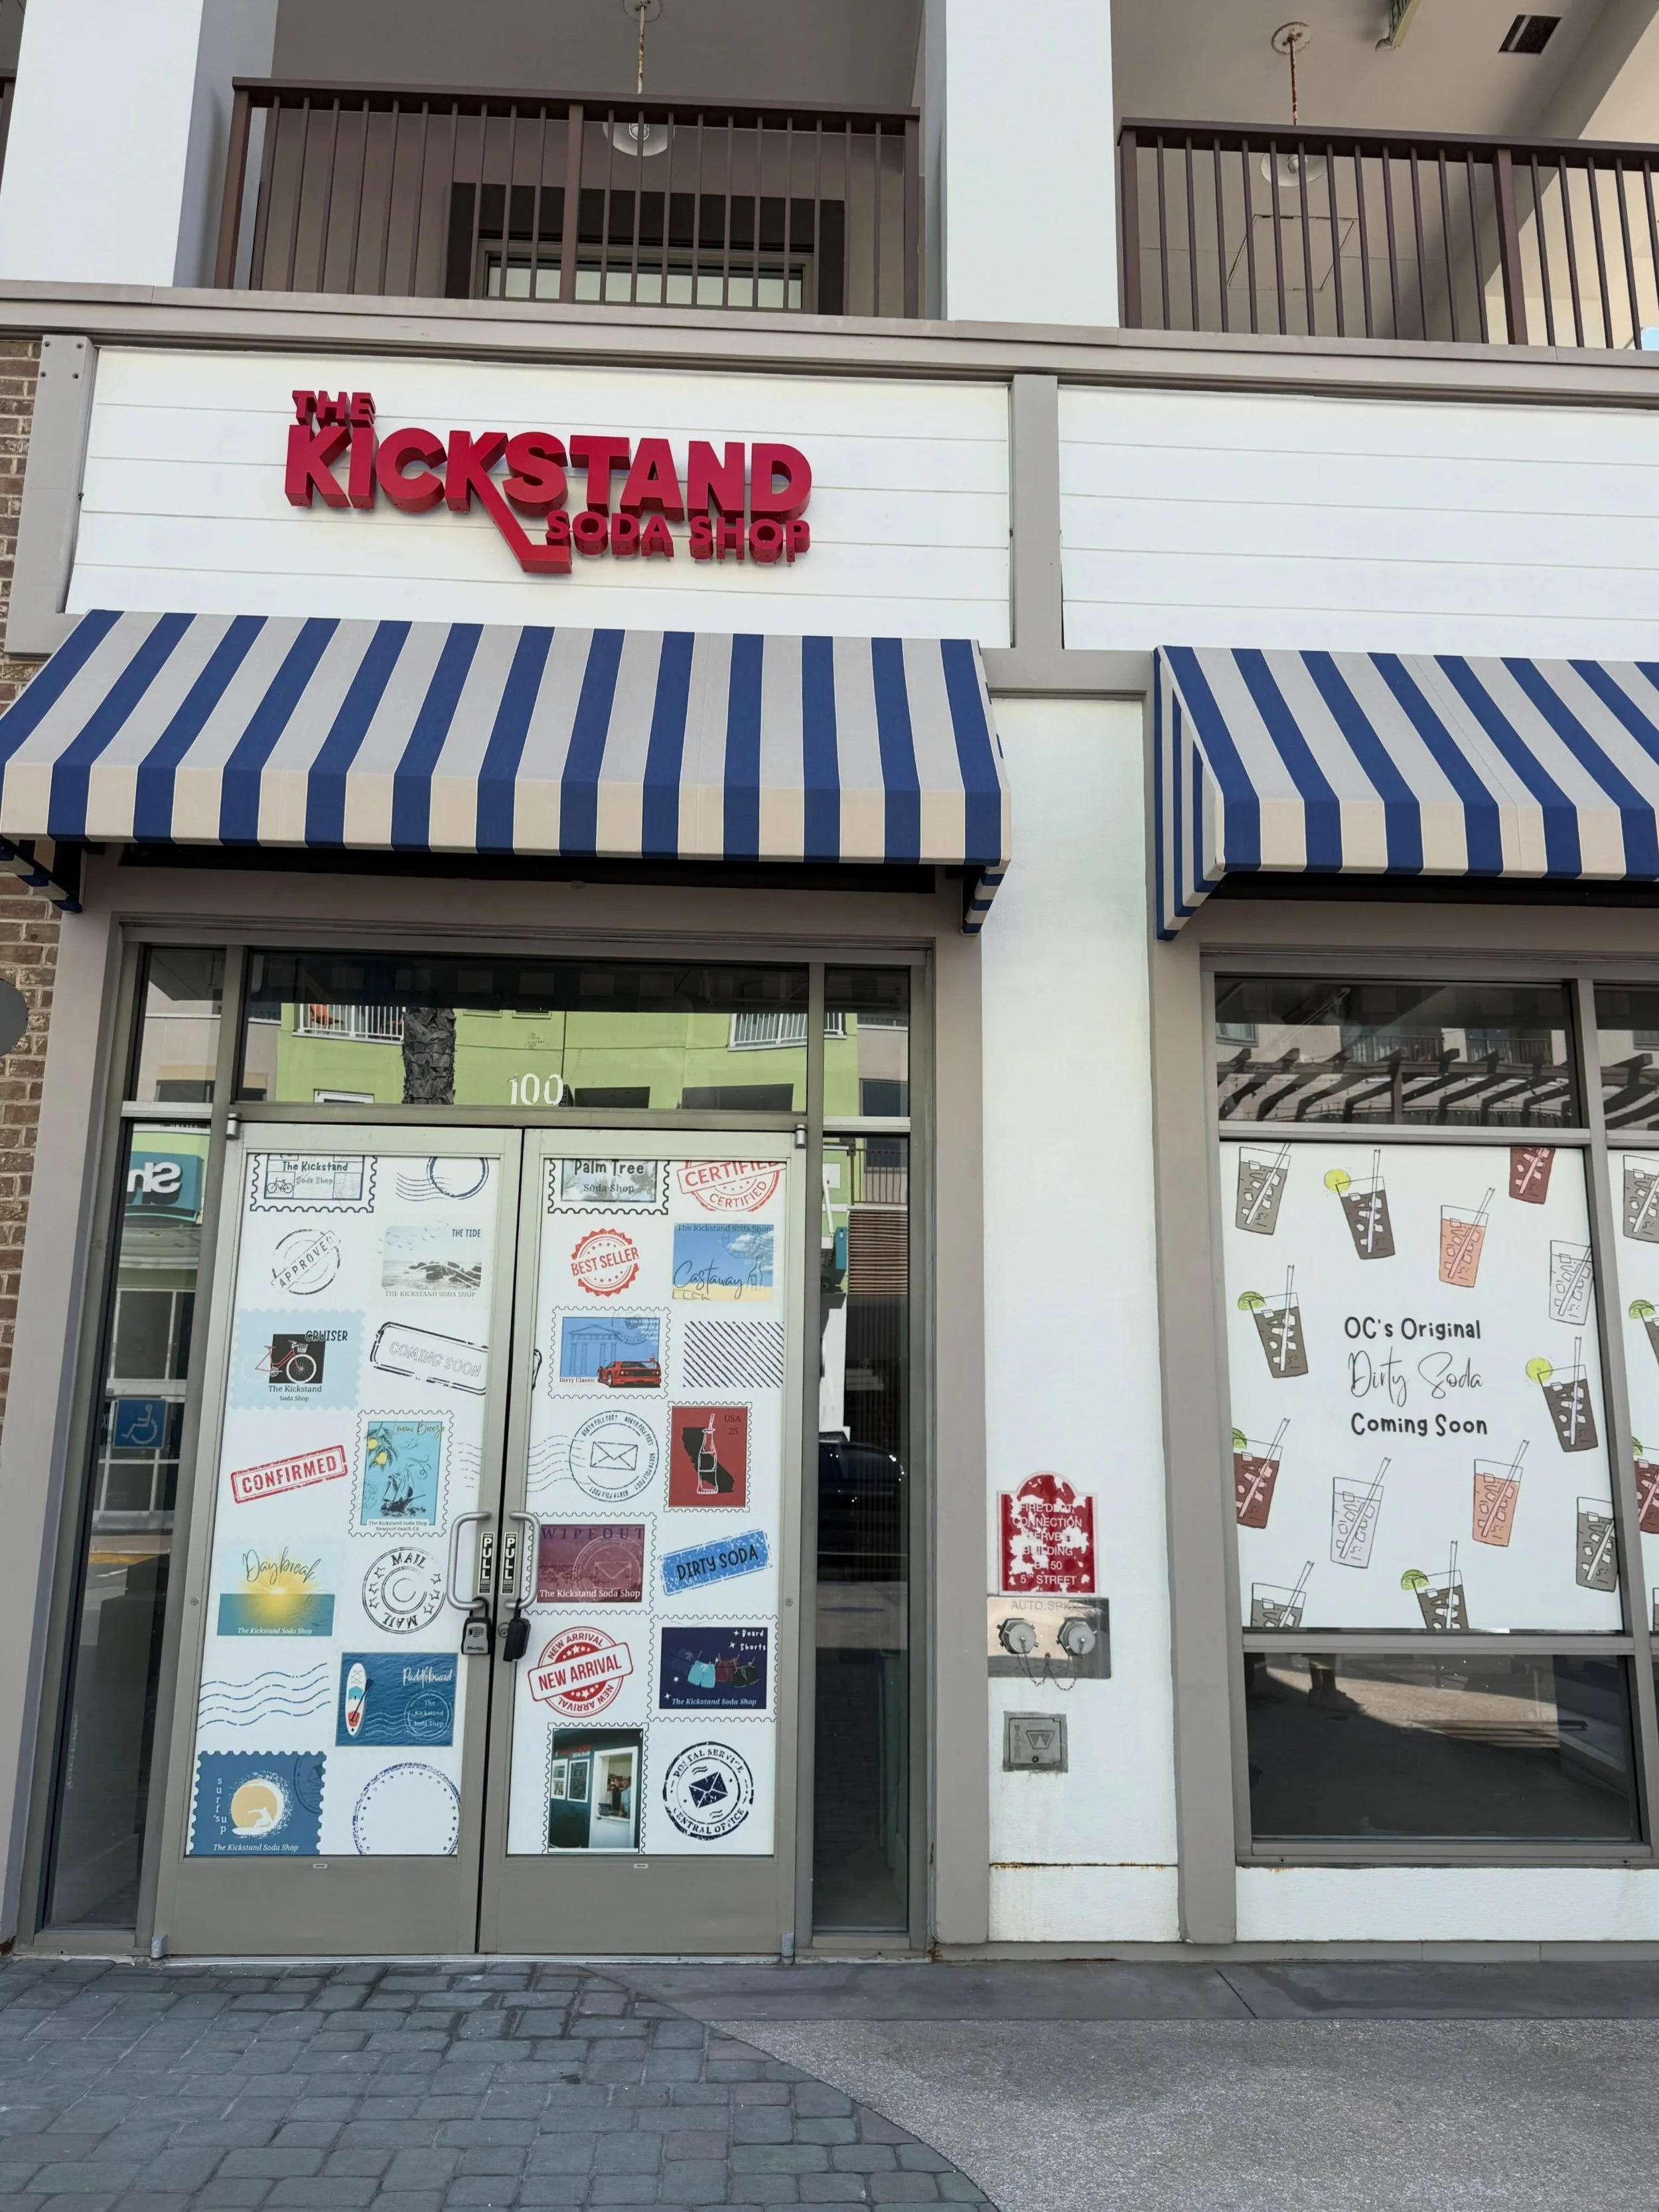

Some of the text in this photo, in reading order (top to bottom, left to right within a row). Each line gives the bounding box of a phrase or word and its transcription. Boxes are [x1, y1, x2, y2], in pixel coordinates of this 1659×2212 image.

[292, 390, 376, 428] THE
[285, 424, 812, 574] KICKSTAND
[545, 510, 810, 563] SODA SHOP
[507, 1073, 563, 1106] 100
[283, 1161, 348, 1171] The Kickstand
[575, 1159, 644, 1175] Palm Tree
[685, 1161, 781, 1187] CERTIFIE
[315, 1177, 332, 1185] Shop
[611, 1184, 634, 1194] Shop
[709, 1181, 766, 1208] CERTIFIED
[452, 1228, 480, 1237] THE TIDE
[752, 1225, 771, 1234] Shop
[571, 1247, 639, 1276] BEST SELLER
[674, 1258, 743, 1299] Castaway
[1344, 1316, 1481, 1341] OC's Original
[390, 1341, 482, 1377] COMING SOON
[1348, 1346, 1483, 1407] Dirty Soda
[1351, 1412, 1488, 1437] Coming Soon
[242, 1455, 336, 1493] CONFIRMED
[1021, 1503, 1043, 1512] FIRE
[541, 1528, 644, 1540] WIPEOUT
[1012, 1517, 1082, 1527] CONNECTION
[1026, 1532, 1072, 1541] ERVE
[242, 1546, 322, 1585] Daybreak
[391, 1552, 427, 1569] MAIL
[482, 1537, 492, 1579] PULL
[504, 1537, 515, 1579] PULL
[676, 1544, 758, 1581] DIRTY SODA
[1036, 1575, 1076, 1585] STREET
[620, 1589, 640, 1599] Shop
[383, 1612, 419, 1629] MAIL
[742, 1629, 764, 1638] Board
[547, 1632, 605, 1660] NEW ARRIVAL
[403, 1666, 453, 1688] Paddleboard
[538, 1654, 622, 1691] NEW ARRIVAL
[557, 1684, 614, 1712] NEW ARRIVAL
[673, 1749, 744, 1778] POSTAL SERVICE
[673, 1807, 711, 1834] CENTRAL
